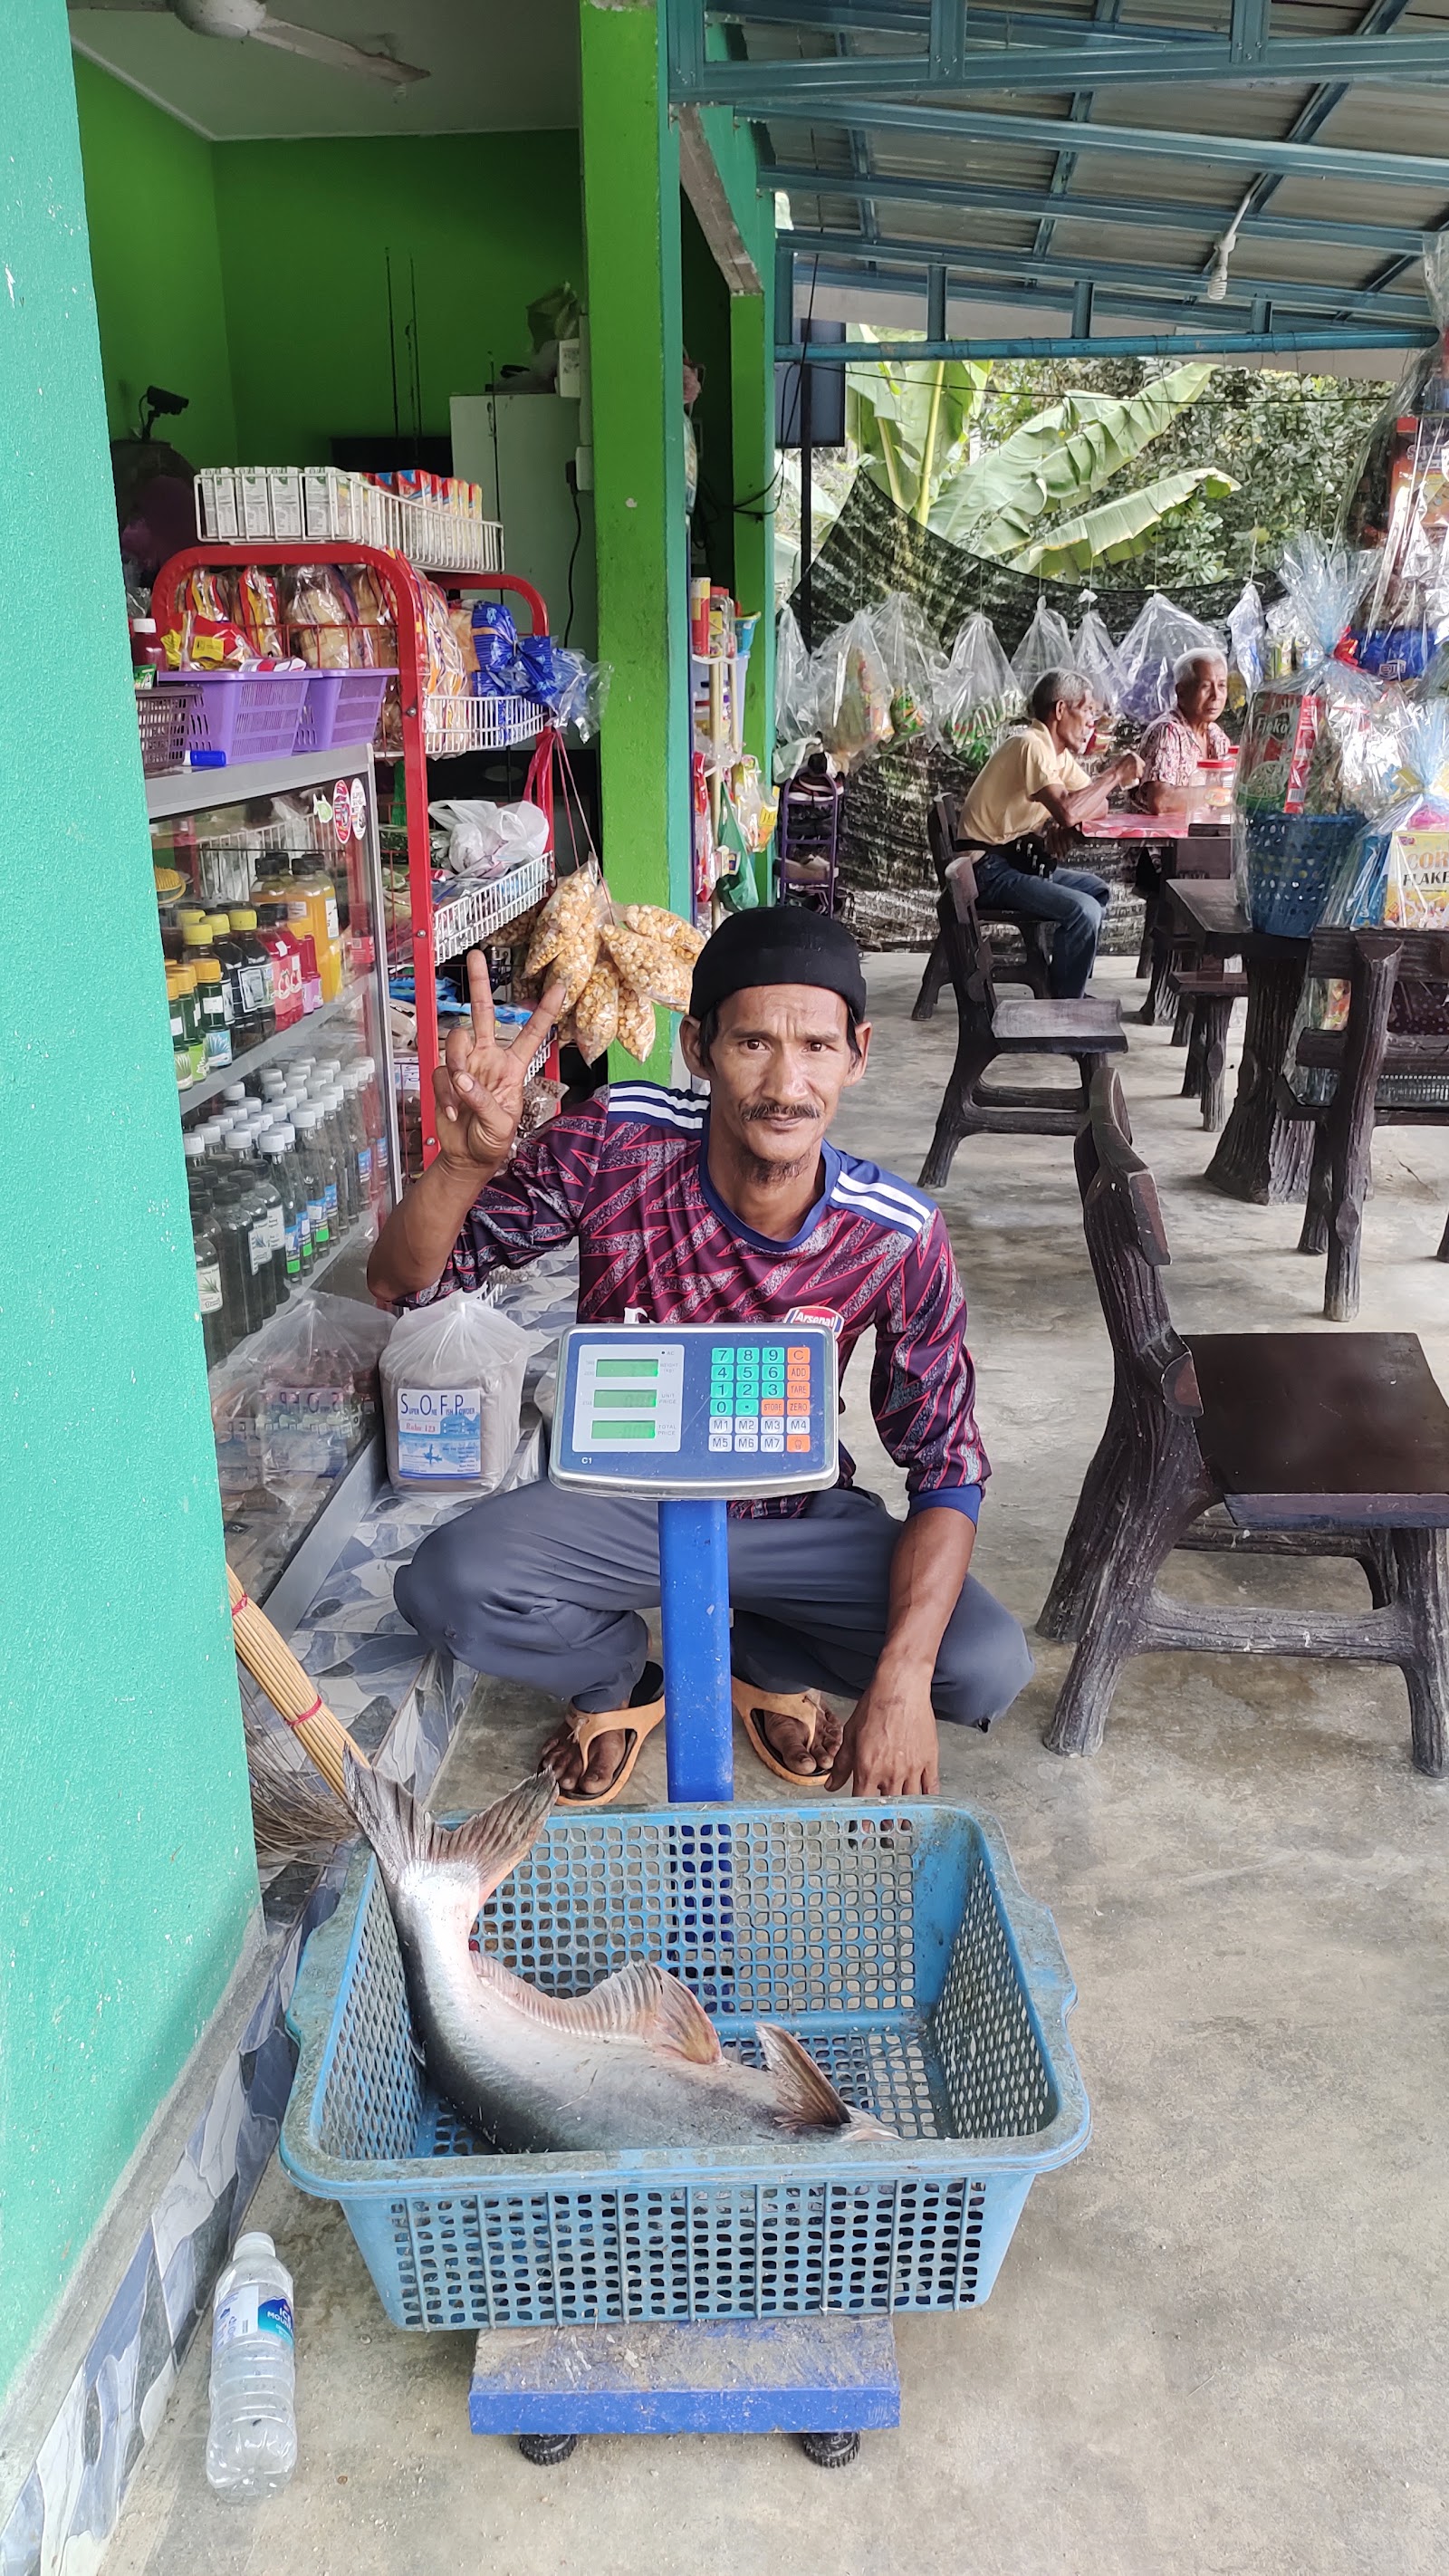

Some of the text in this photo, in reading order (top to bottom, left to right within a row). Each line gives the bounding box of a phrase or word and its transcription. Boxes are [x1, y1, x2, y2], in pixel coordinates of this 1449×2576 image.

[795, 1312, 835, 1328] Arsenal
[718, 1349, 804, 1361] 7 8 9 C
[717, 1366, 806, 1379] 4 5 6 ADD
[717, 1383, 807, 1396] 1 2 3 TARE
[716, 1401, 726, 1413] 0
[764, 1403, 782, 1411] STORE
[790, 1403, 808, 1411] ZERO
[714, 1420, 807, 1429] M1 M2 M3 M4
[713, 1438, 780, 1447] M5 M6 M7
